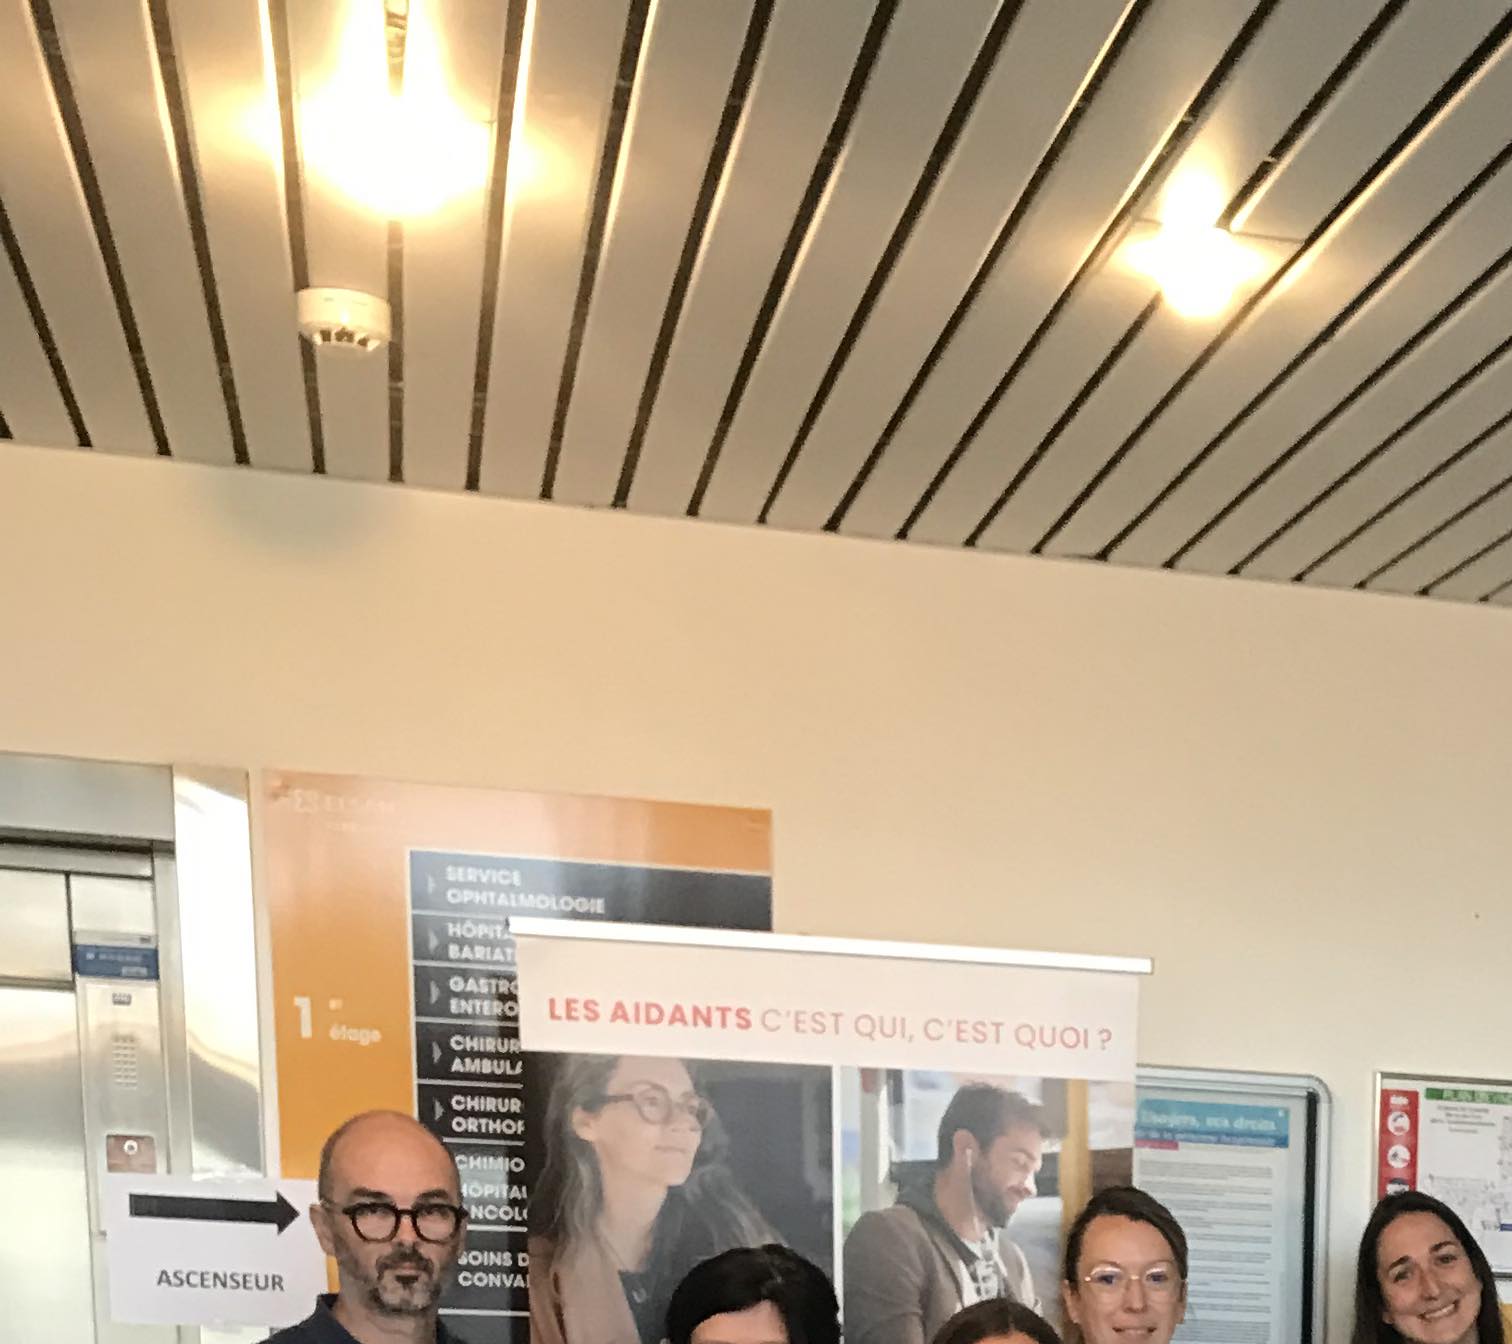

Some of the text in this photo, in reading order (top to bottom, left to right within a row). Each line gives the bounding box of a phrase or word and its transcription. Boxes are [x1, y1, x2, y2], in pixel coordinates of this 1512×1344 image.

[446, 865, 521, 886] SERVICE
[446, 887, 605, 914] OPHTALMOLOGIE
[294, 996, 312, 1038] 1
[547, 996, 1114, 1052] LES AIDANTS C'EST QUI, C'EST QUOI ?
[330, 1022, 382, 1046] étage
[157, 1268, 285, 1293] ASCENSEUR
